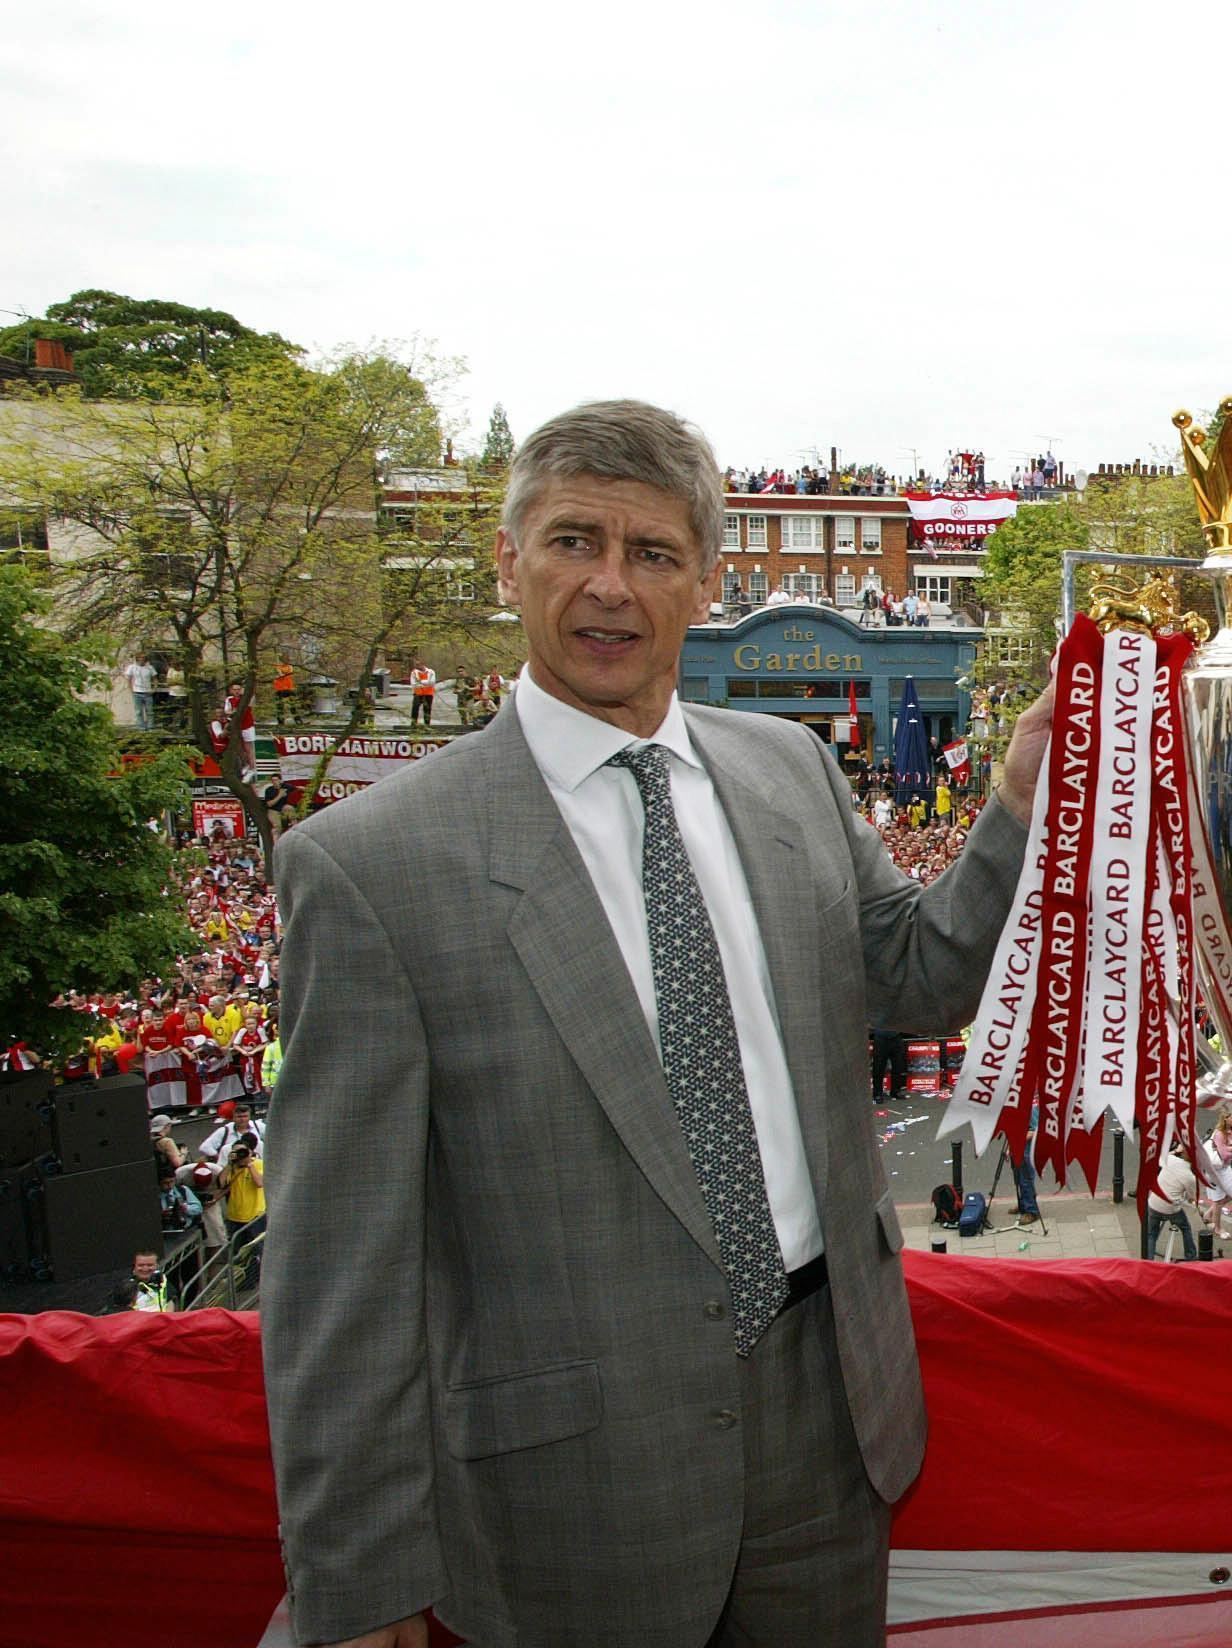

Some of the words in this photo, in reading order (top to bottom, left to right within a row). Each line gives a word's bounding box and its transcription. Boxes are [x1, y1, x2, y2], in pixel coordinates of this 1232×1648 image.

[783, 625, 814, 642] the
[923, 523, 997, 535] GOONERS
[733, 644, 863, 672] Garden
[1053, 662, 1095, 897] BARCLAYCARD
[1153, 665, 1185, 895] BARCLAYCARD
[969, 889, 1043, 1107] BARCLAYCARD
[1044, 911, 1076, 1140] BARCLAYCARD
[1100, 858, 1130, 1087] BARCLAYCARD
